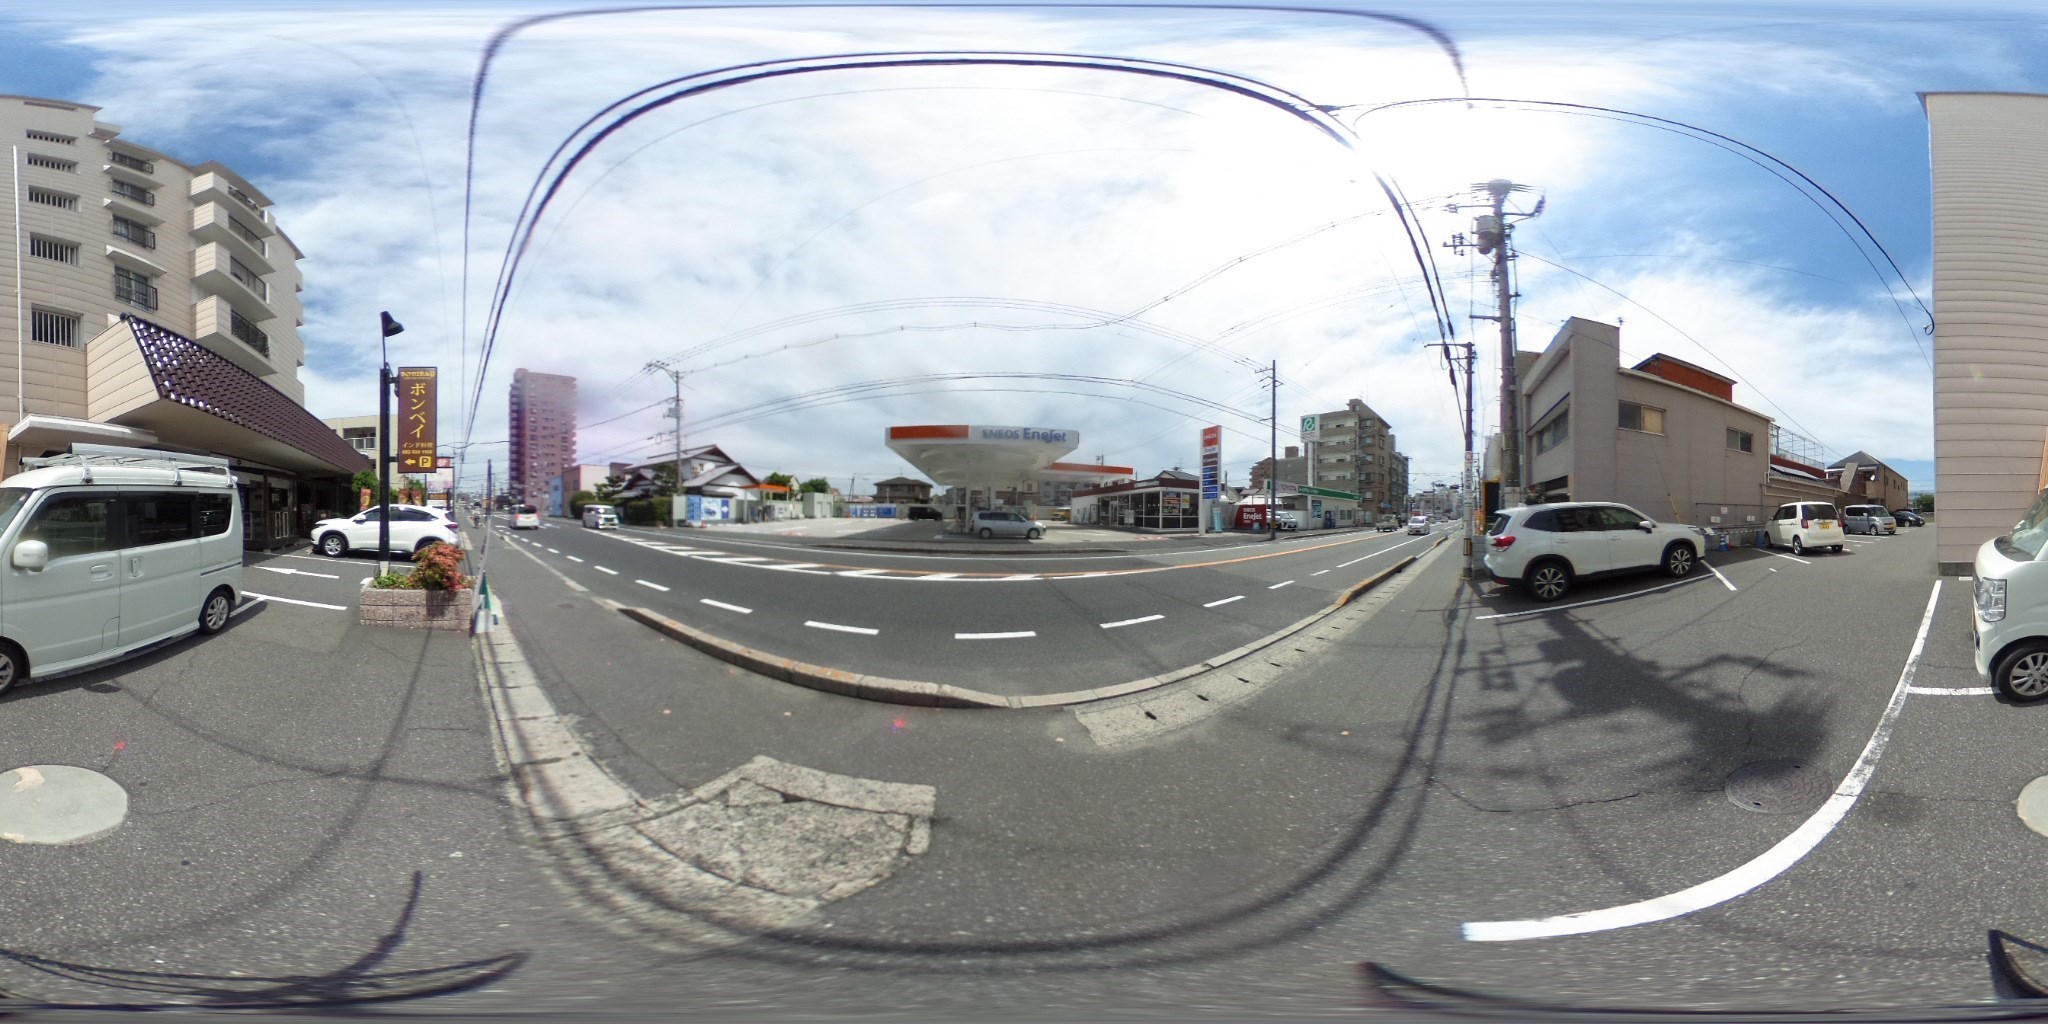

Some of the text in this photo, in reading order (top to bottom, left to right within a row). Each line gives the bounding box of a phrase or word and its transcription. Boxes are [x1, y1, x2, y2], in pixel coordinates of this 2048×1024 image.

[410, 383, 426, 438] ボンベイ
[982, 427, 1067, 443] ENEOS EneJet
[1280, 483, 1297, 492] TOYOTA
